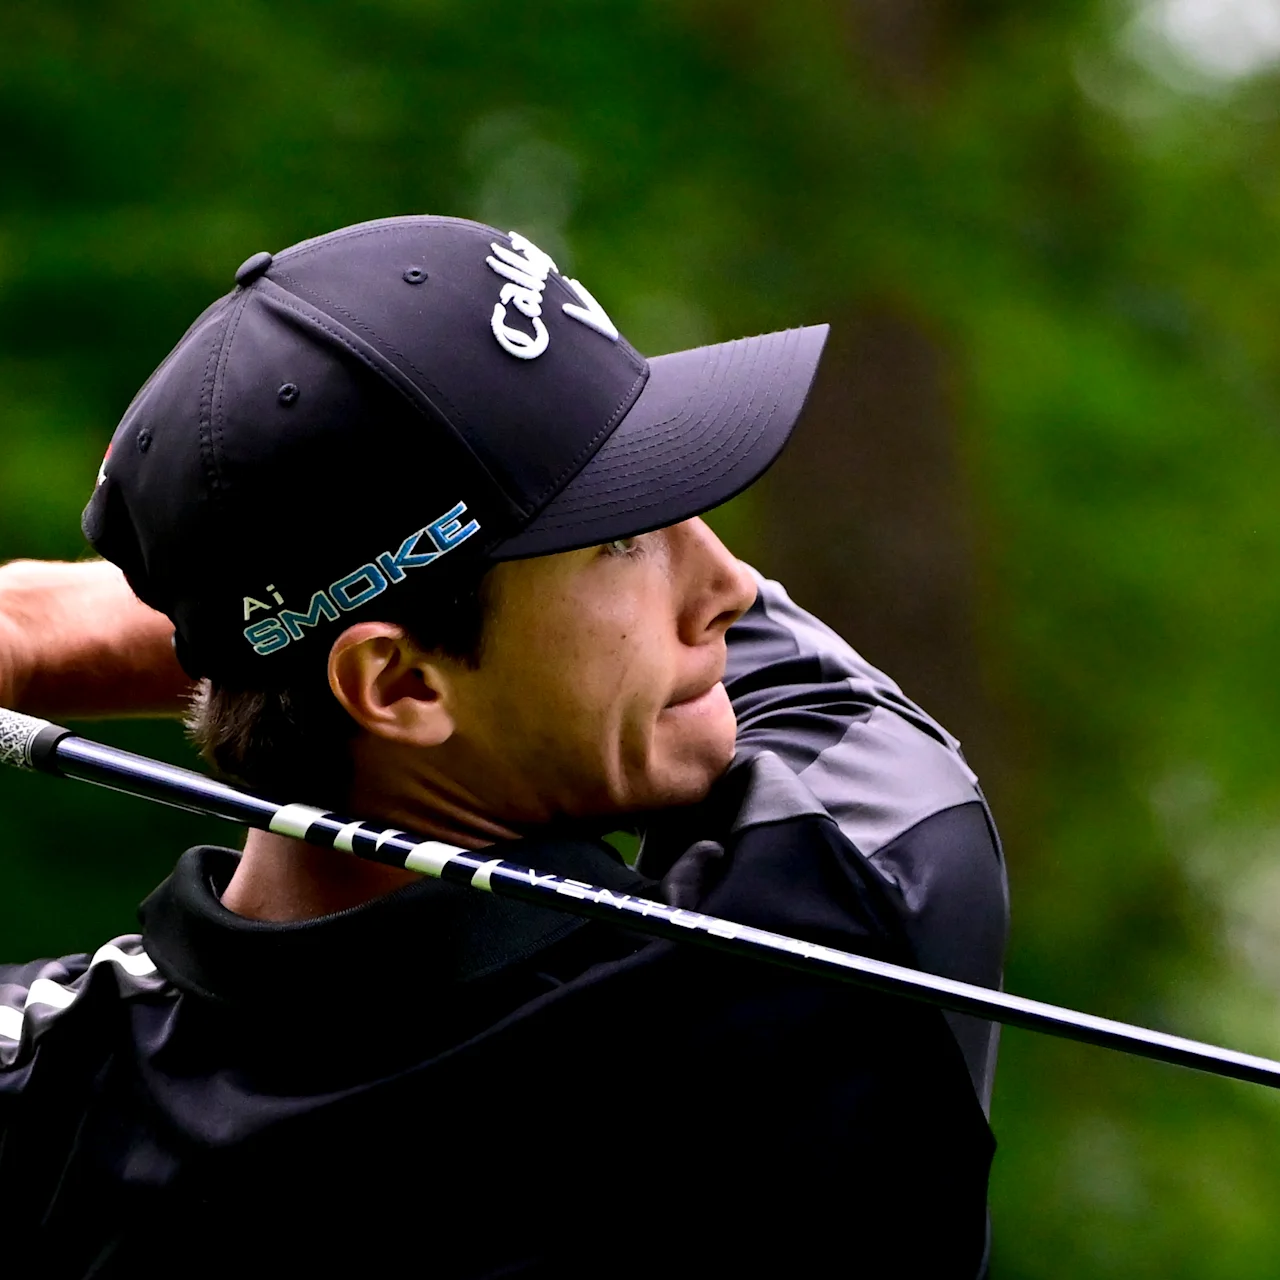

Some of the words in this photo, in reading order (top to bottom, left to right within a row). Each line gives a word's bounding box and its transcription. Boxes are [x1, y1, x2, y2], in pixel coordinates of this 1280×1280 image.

[243, 500, 481, 655] SMOKE
[243, 583, 285, 621] Ai
[528, 868, 741, 940] VENTUS
